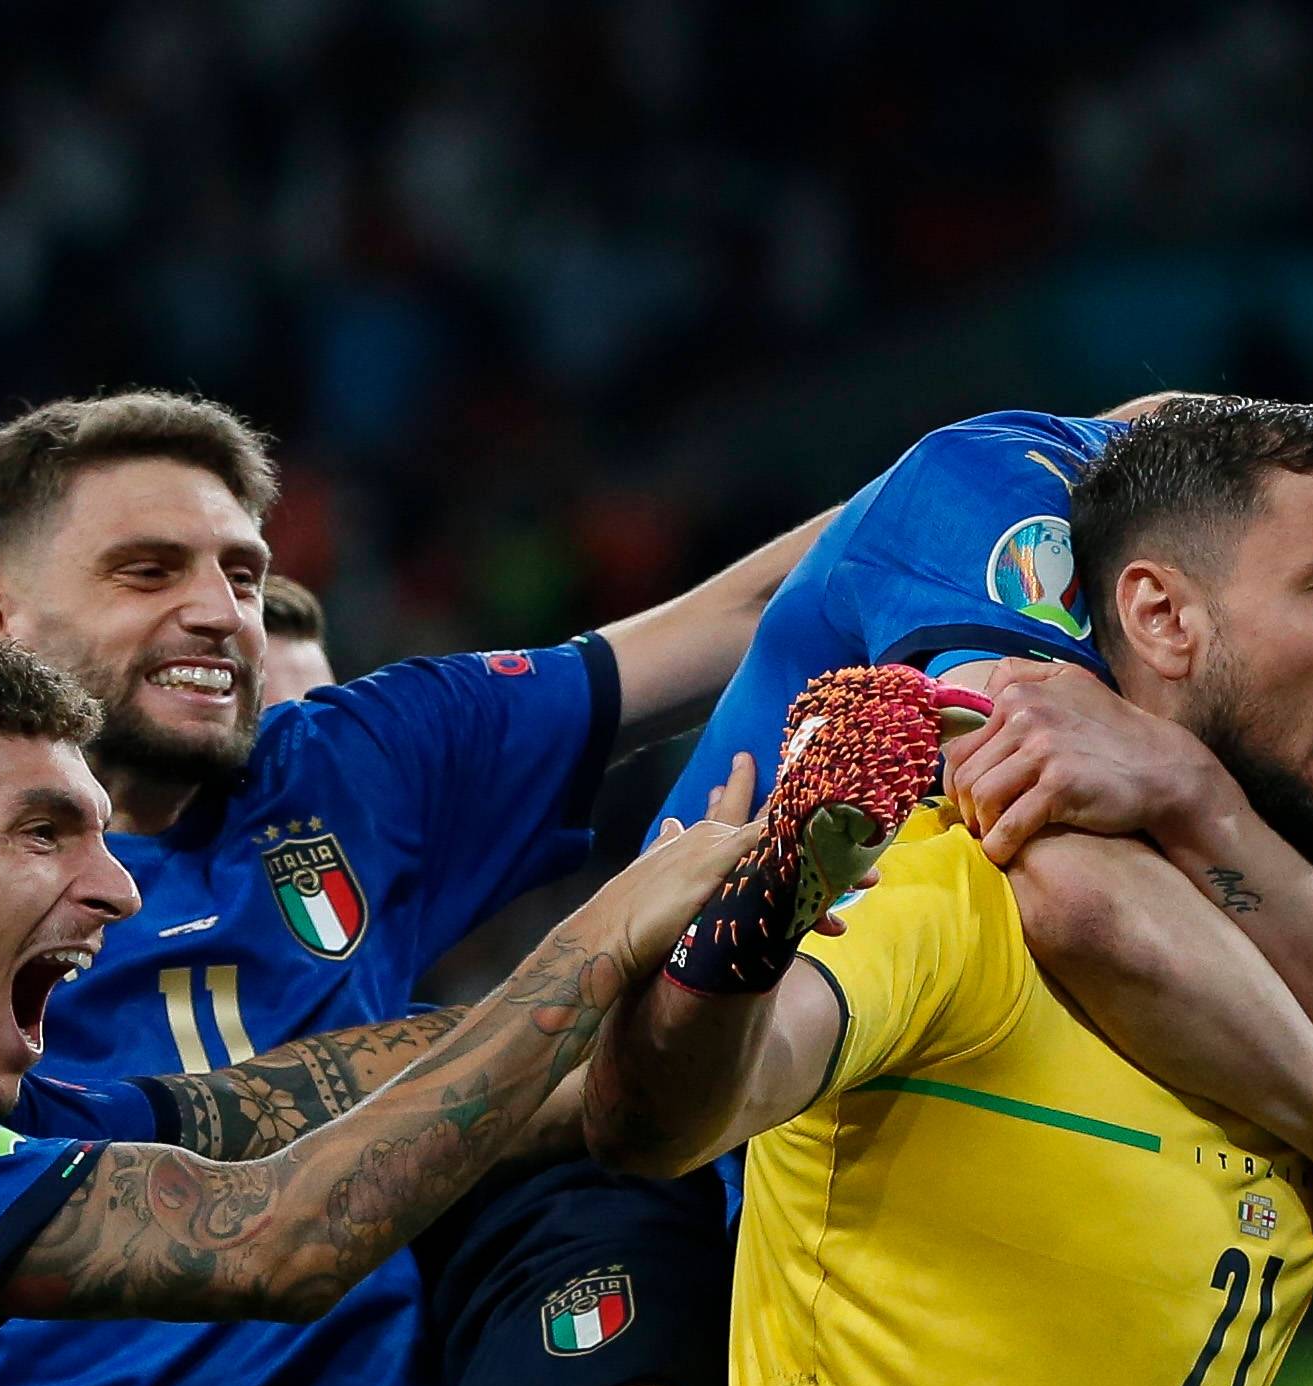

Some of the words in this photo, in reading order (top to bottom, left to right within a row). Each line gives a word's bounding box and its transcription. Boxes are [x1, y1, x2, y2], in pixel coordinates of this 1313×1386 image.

[268, 844, 333, 876] ITALIA
[158, 964, 256, 1075] 11
[550, 1280, 620, 1314] ITALIA
